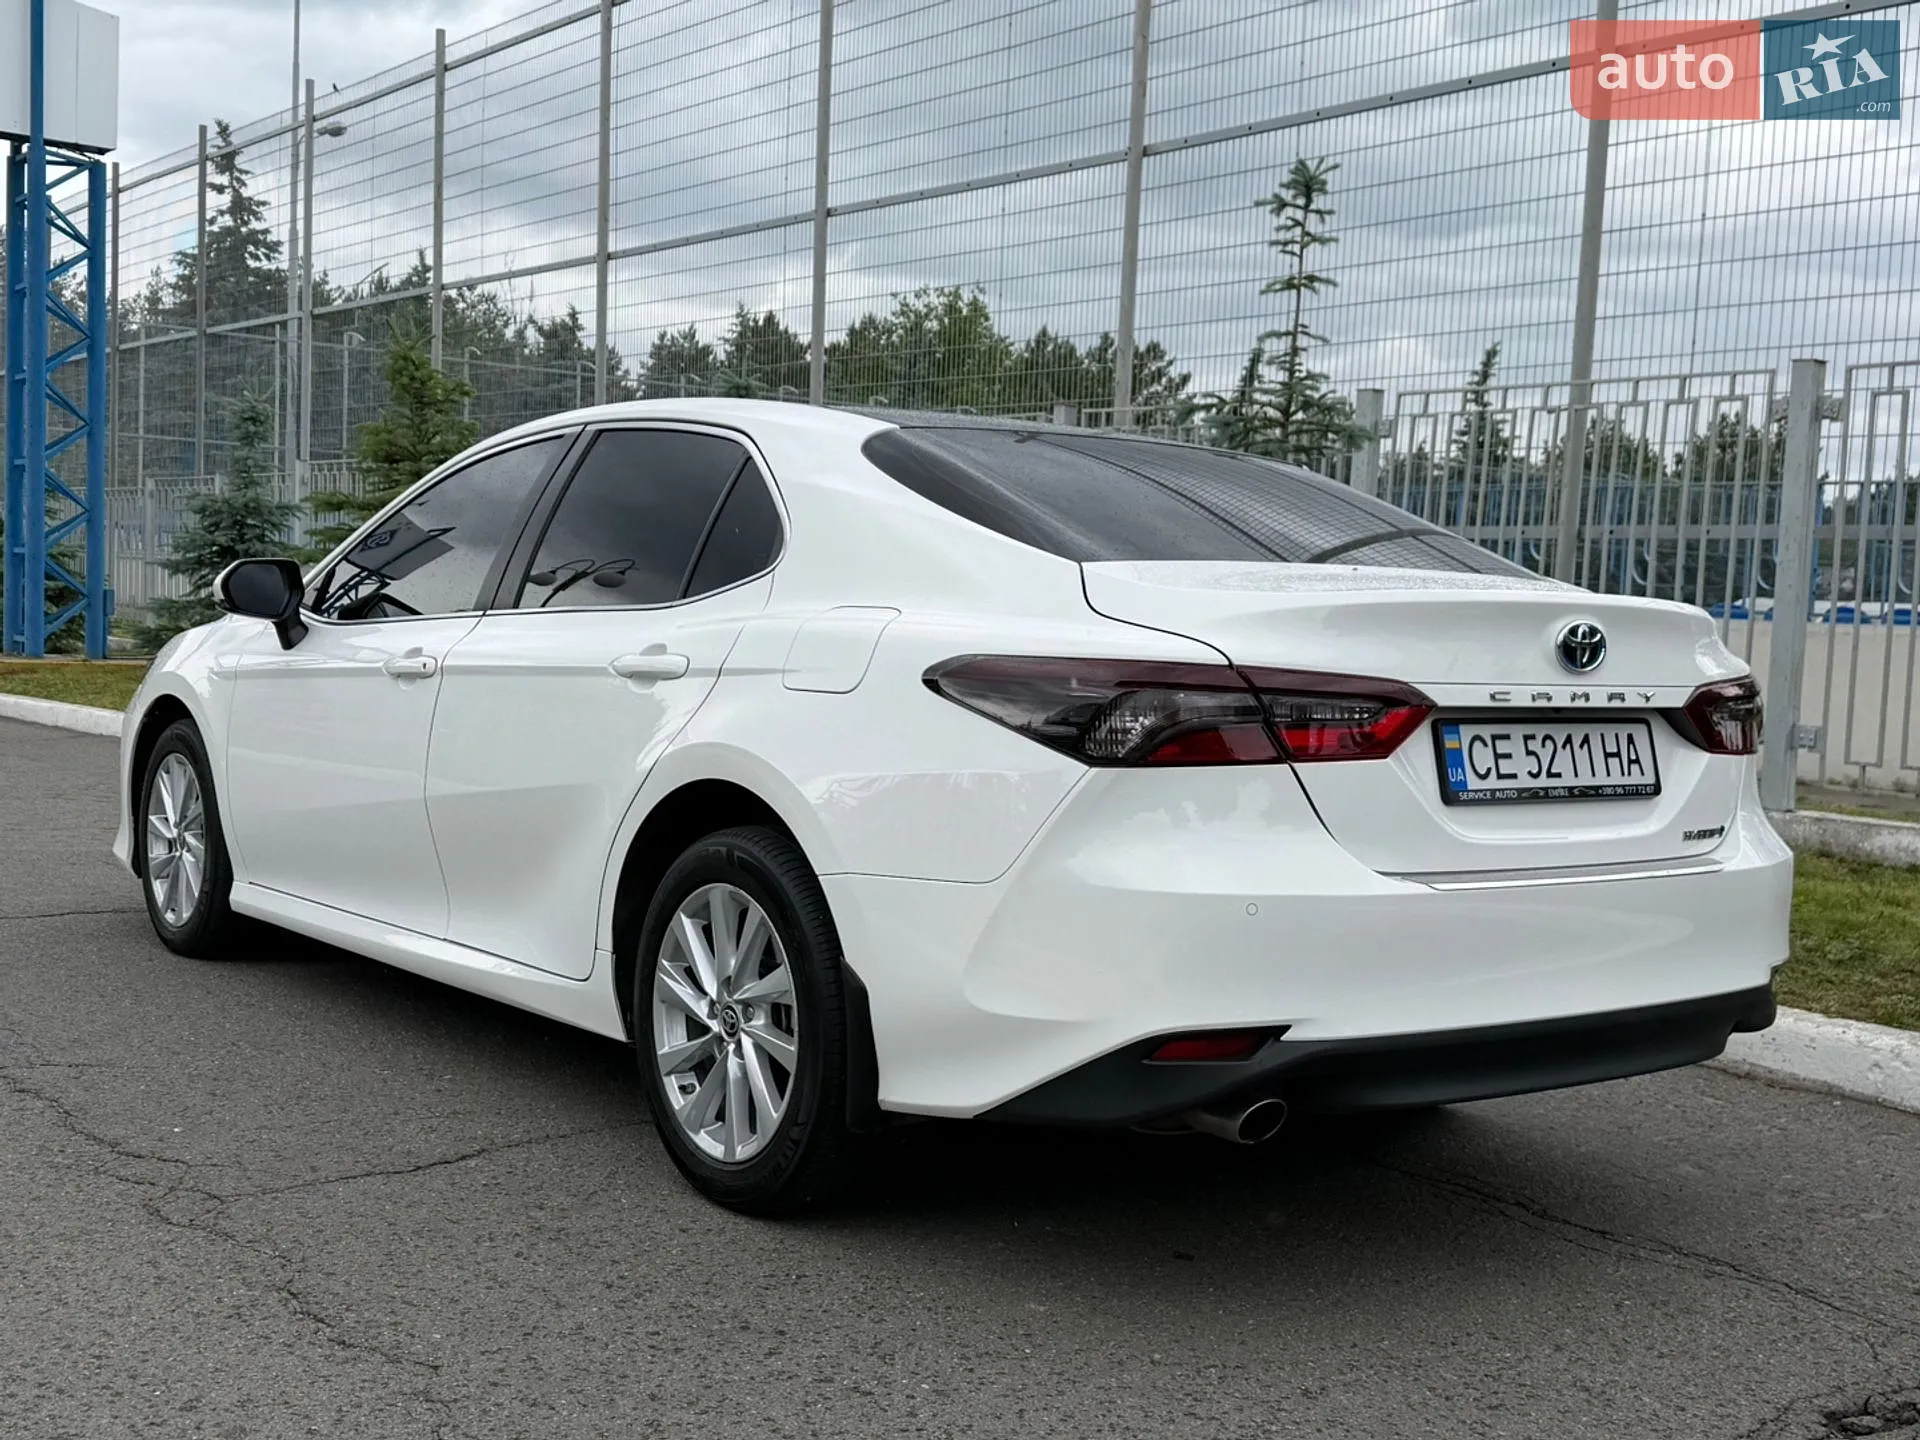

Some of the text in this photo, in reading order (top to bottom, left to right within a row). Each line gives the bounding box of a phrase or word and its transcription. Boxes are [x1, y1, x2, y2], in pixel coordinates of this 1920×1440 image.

[1489, 691, 1656, 704] CAMRY
[1468, 732, 1645, 781] CE 5211 HA
[1448, 768, 1465, 782] UA
[1459, 790, 1492, 800] SERVICE
[1495, 789, 1518, 799] AUTO
